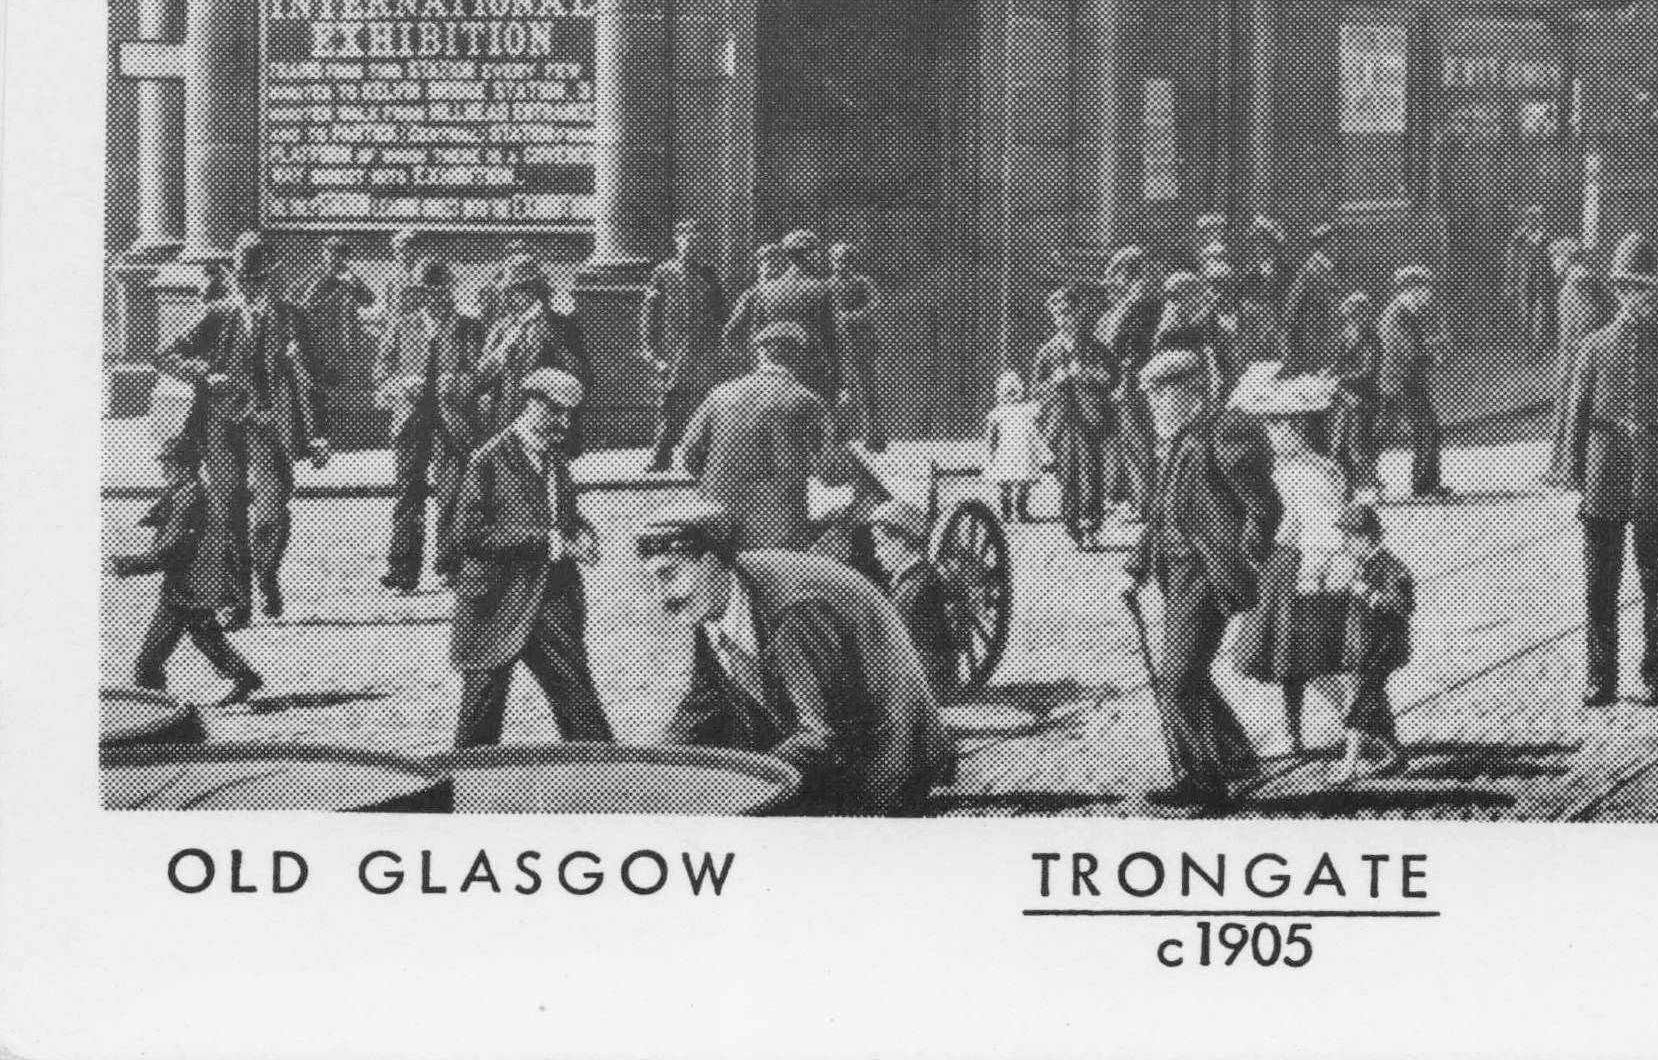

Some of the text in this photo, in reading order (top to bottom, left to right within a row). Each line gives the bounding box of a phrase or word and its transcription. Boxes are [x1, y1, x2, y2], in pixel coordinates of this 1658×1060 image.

[310, 21, 550, 58] EXHIBITION
[544, 63, 581, 79] FEW
[1441, 55, 1499, 90] EXIT
